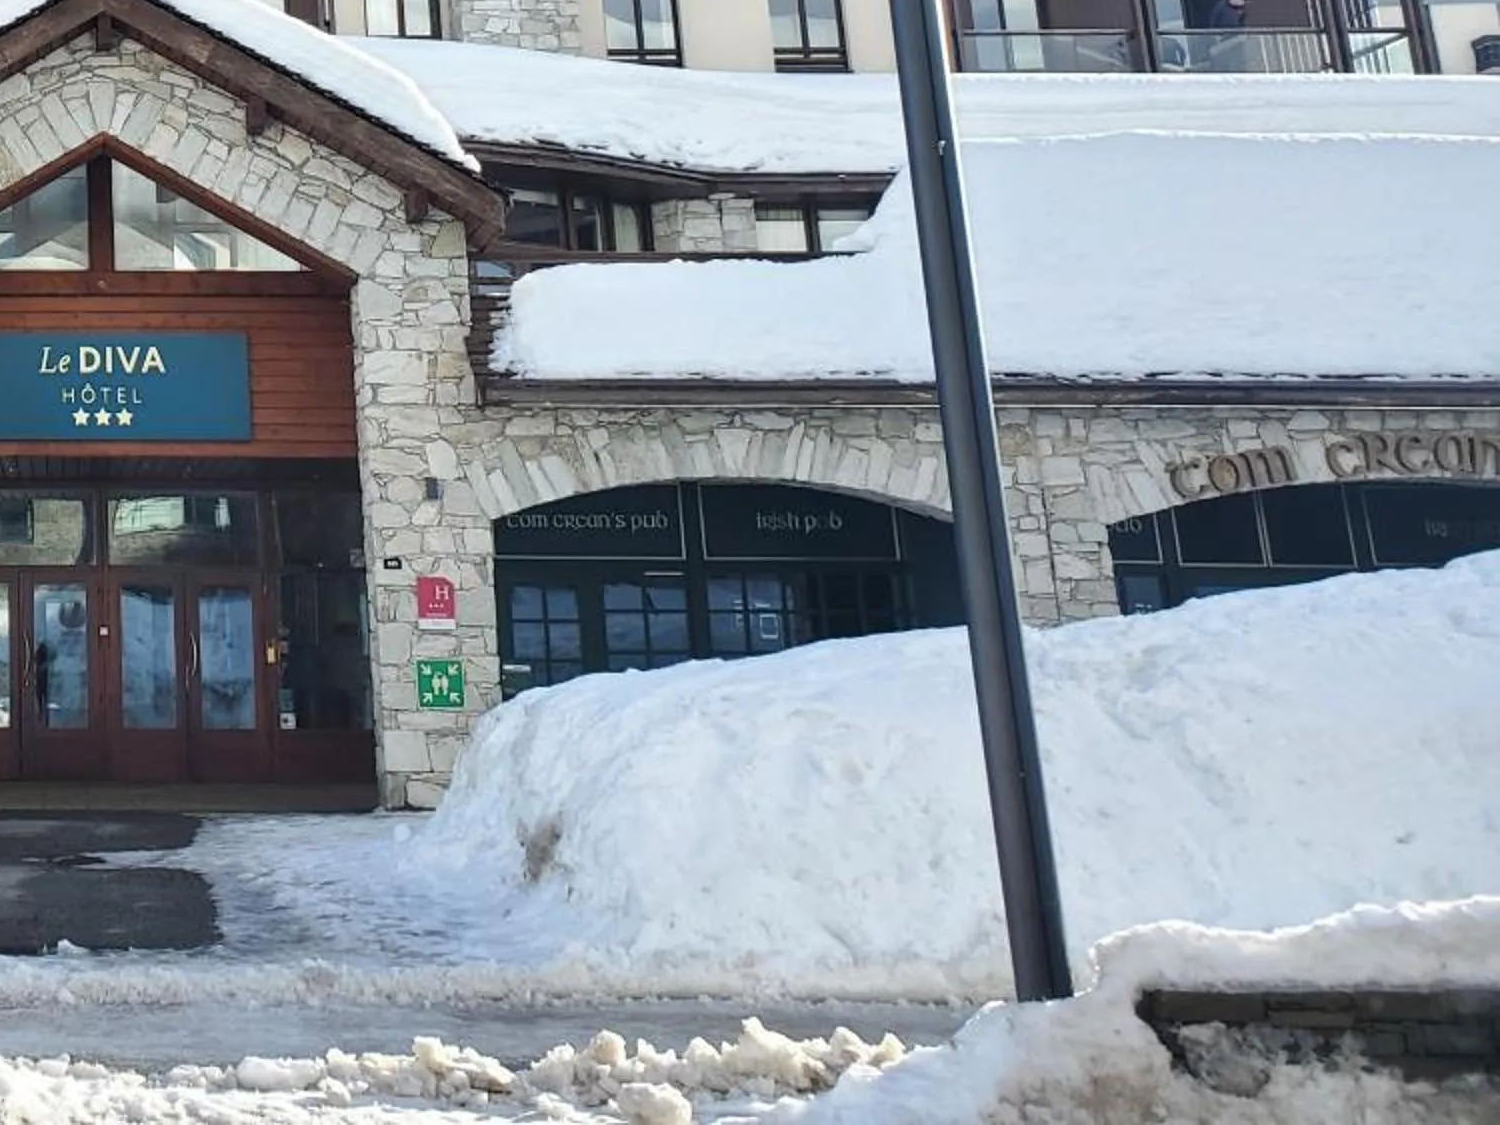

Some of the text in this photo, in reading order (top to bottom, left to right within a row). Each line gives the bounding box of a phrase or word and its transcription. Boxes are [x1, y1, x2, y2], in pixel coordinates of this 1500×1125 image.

[39, 346, 166, 374] Le DIVA
[62, 382, 142, 404] HÔTEL
[804, 509, 844, 534] pb
[435, 584, 449, 600] H
